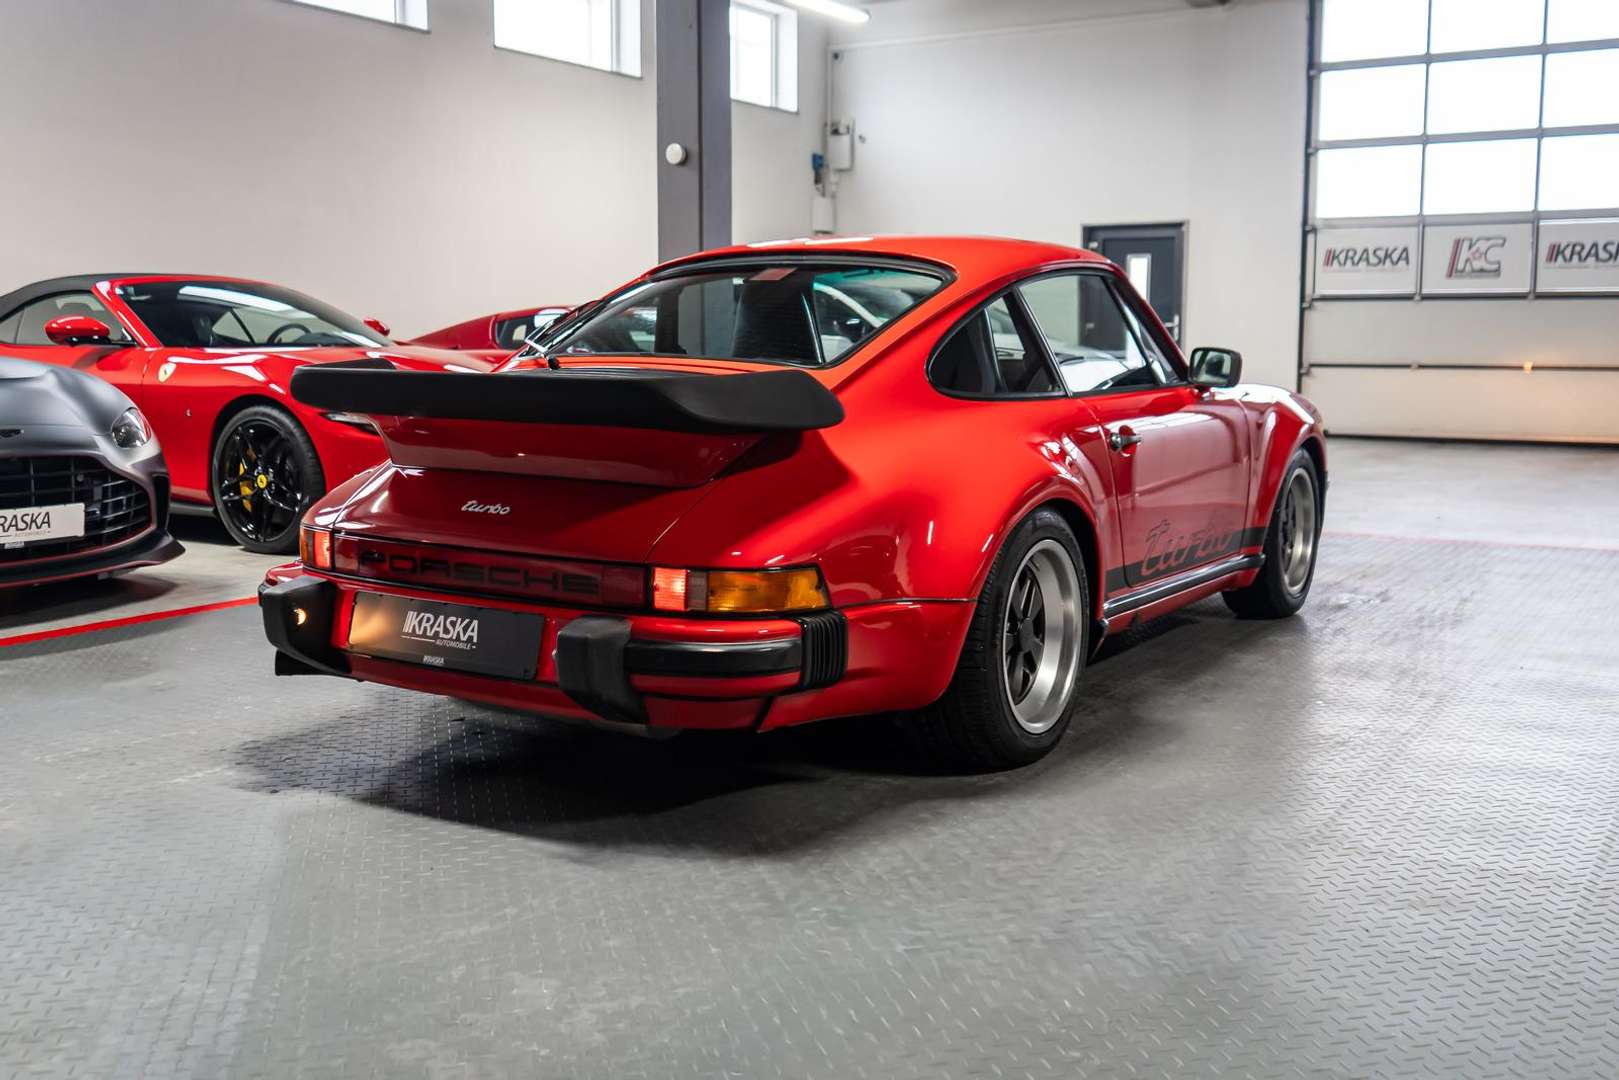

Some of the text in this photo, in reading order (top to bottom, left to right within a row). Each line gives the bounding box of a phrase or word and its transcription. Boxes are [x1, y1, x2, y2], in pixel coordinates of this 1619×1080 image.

[1330, 246, 1410, 267] KRASKA
[461, 500, 511, 515] turbo
[360, 550, 600, 595] PORSCHE
[407, 611, 479, 643] KRASKA
